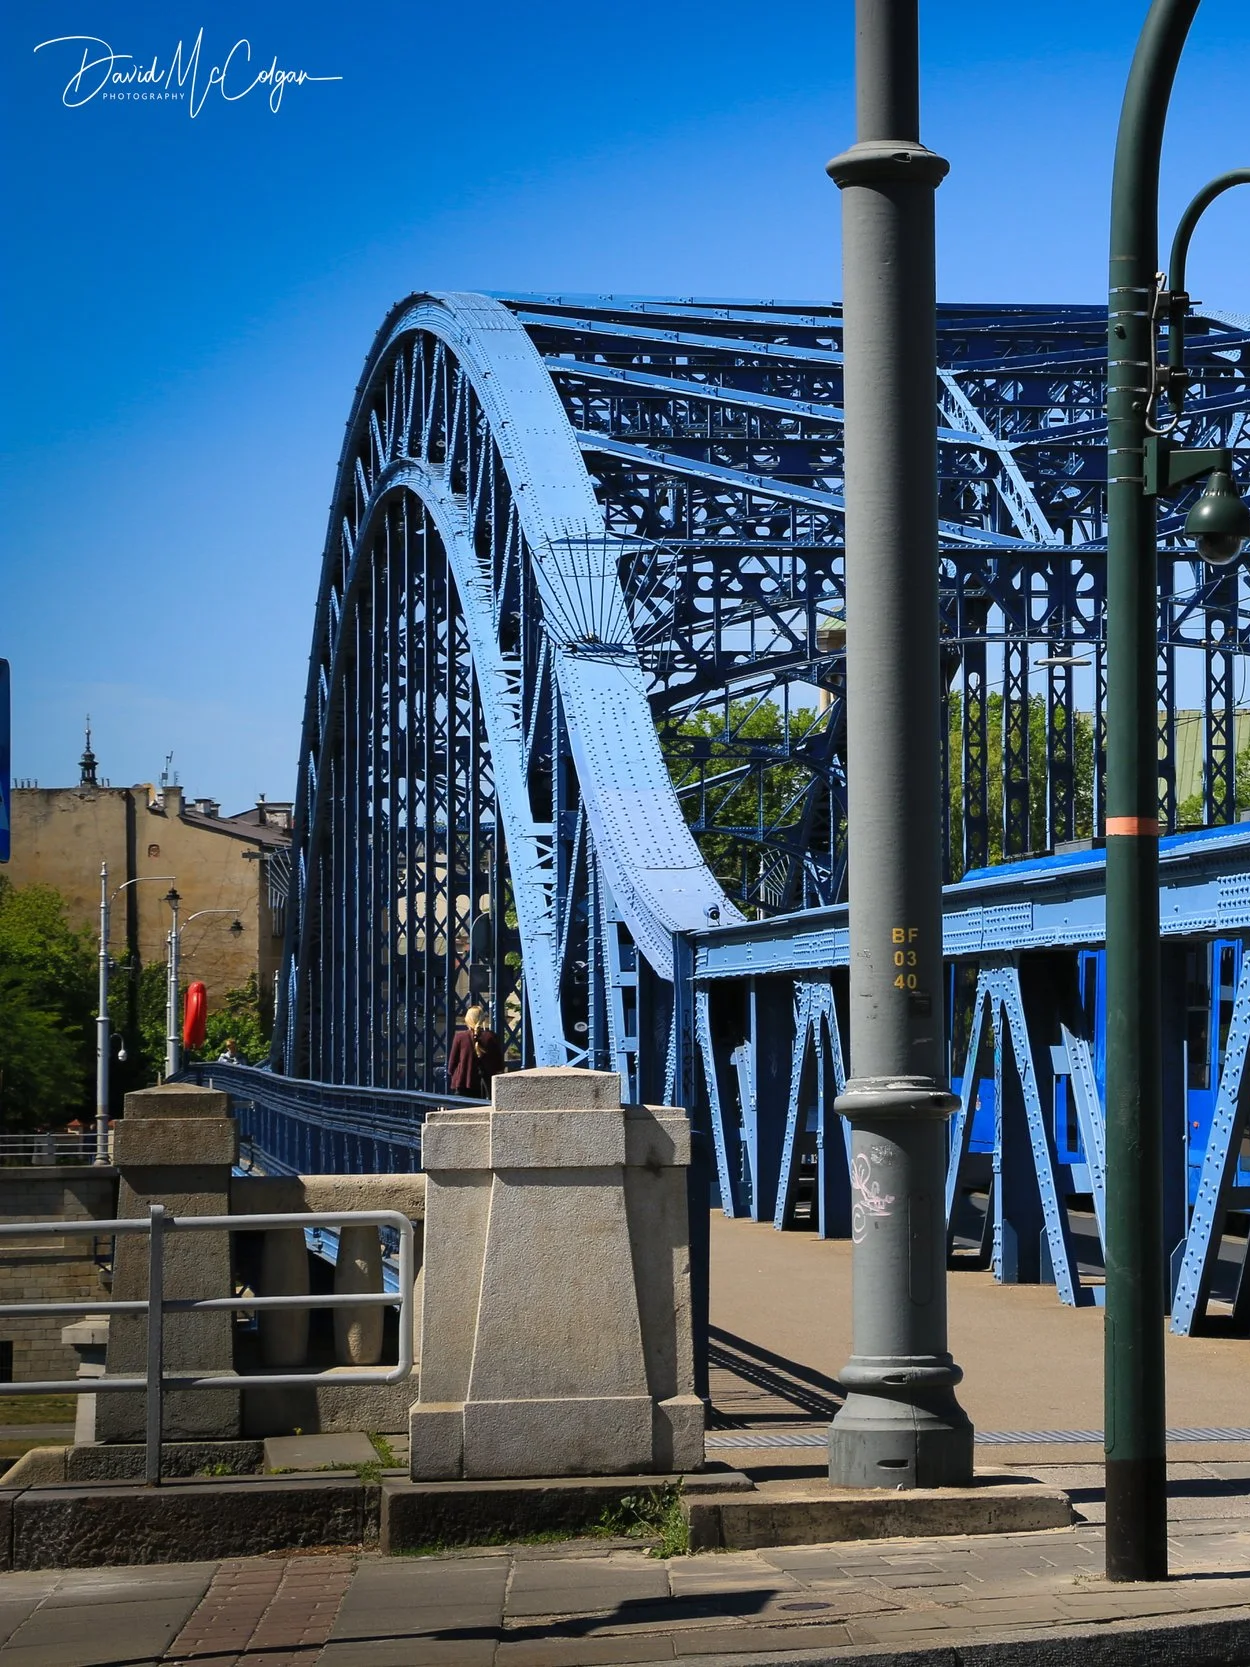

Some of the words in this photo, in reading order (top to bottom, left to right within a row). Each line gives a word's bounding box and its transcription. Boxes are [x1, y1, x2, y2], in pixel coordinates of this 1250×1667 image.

[891, 927, 919, 944] BF
[893, 950, 917, 967] 03
[893, 973, 917, 990] 40
